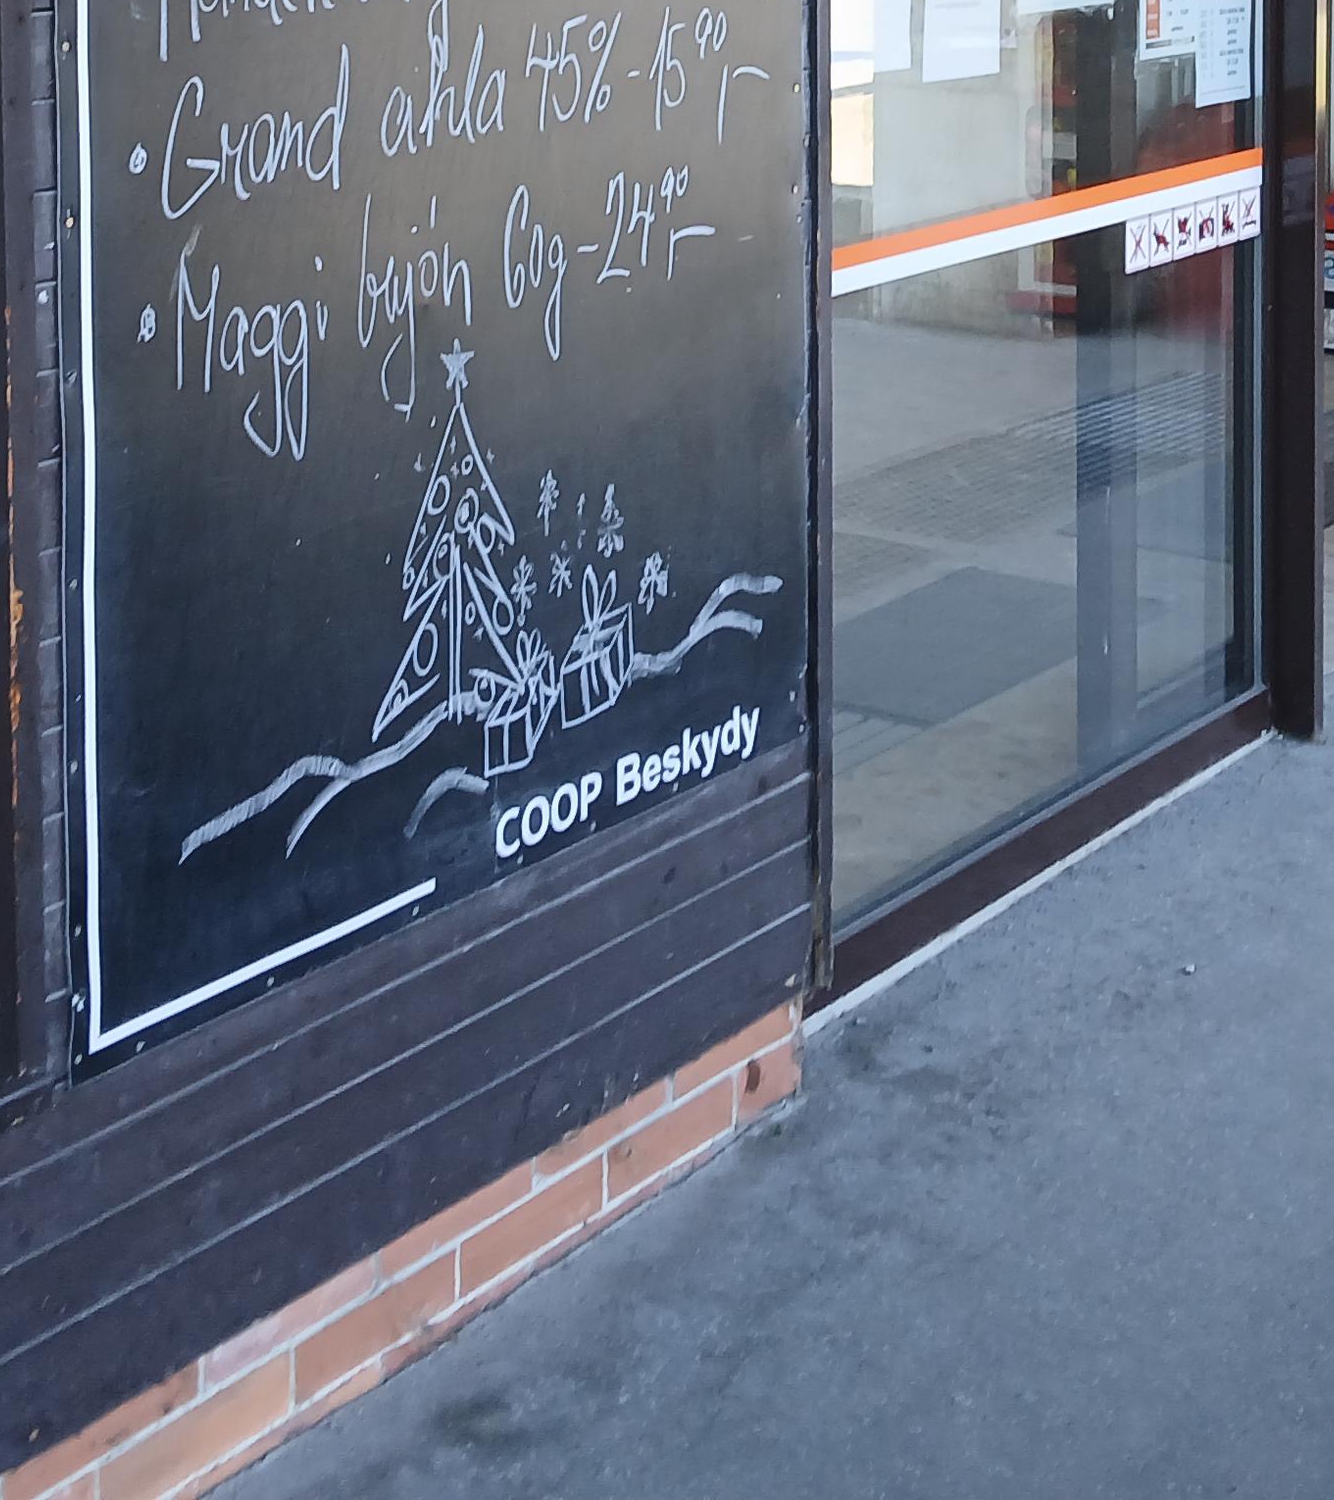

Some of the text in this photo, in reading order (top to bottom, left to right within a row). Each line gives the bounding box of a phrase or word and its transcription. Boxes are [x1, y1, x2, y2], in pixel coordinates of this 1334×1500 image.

[160, 43, 351, 220] Grand
[175, 248, 331, 461] Maggi
[496, 705, 760, 859] COOP Beskydy
